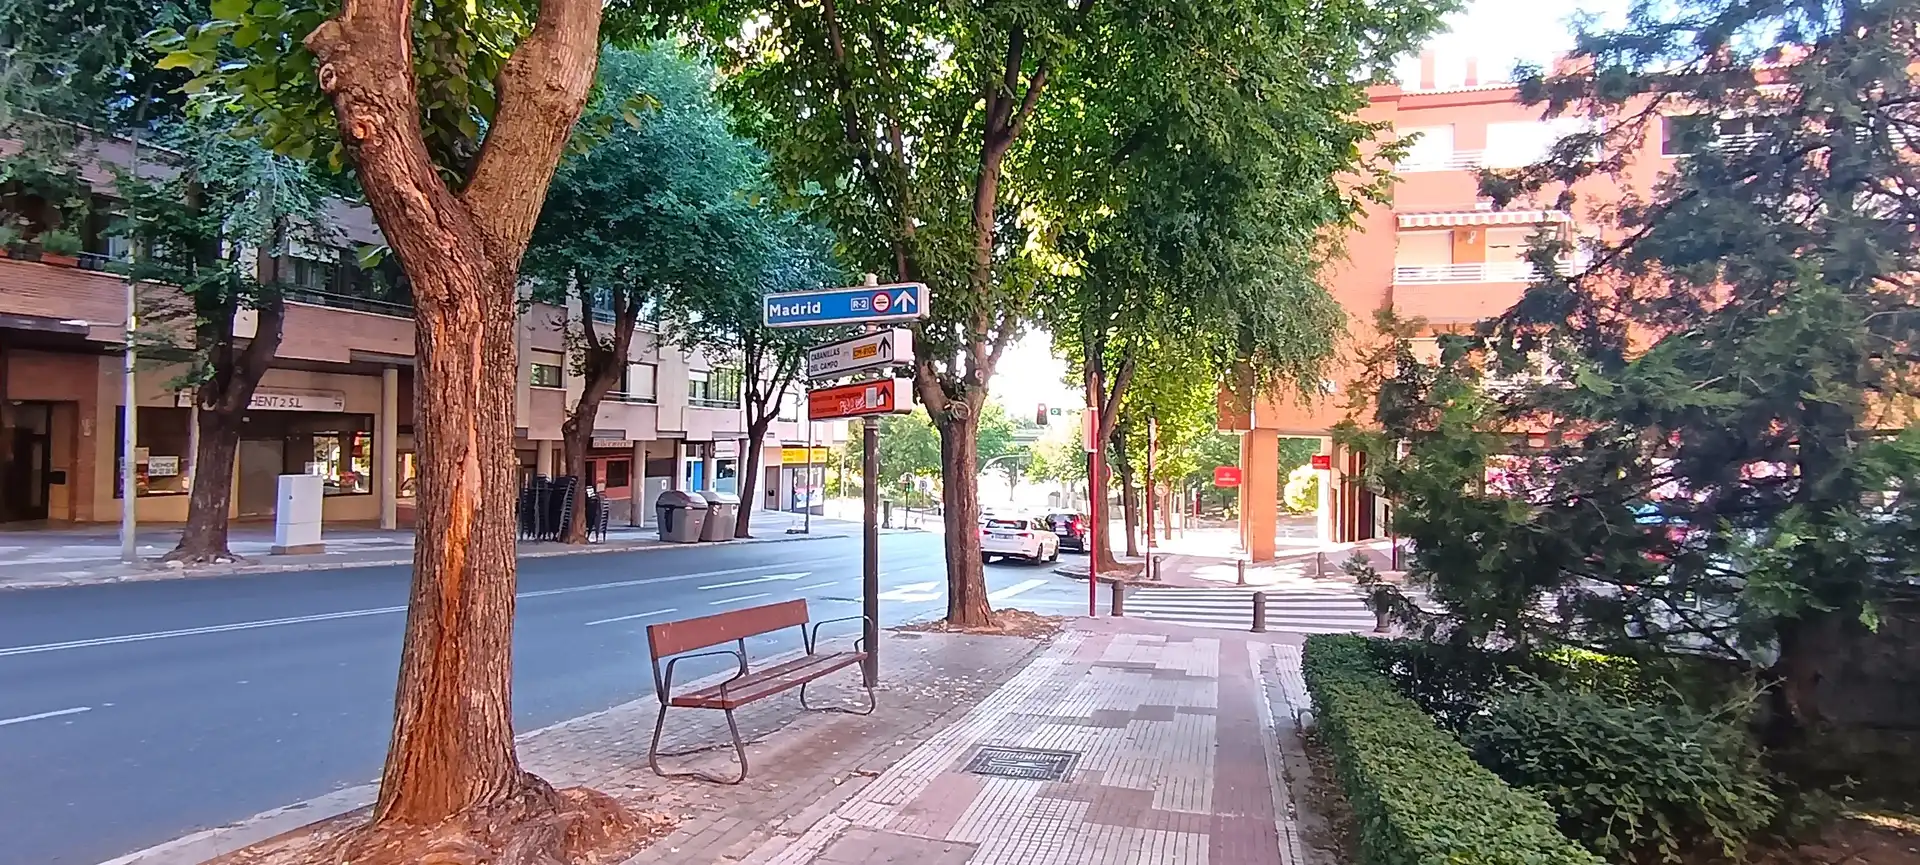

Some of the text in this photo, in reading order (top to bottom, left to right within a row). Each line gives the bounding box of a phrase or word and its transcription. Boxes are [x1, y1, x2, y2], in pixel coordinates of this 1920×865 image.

[769, 300, 866, 317] Madrid R-2
[811, 347, 840, 361] CABANILLAS
[811, 360, 838, 372] DEL CAMPO
[279, 398, 286, 407] 2
